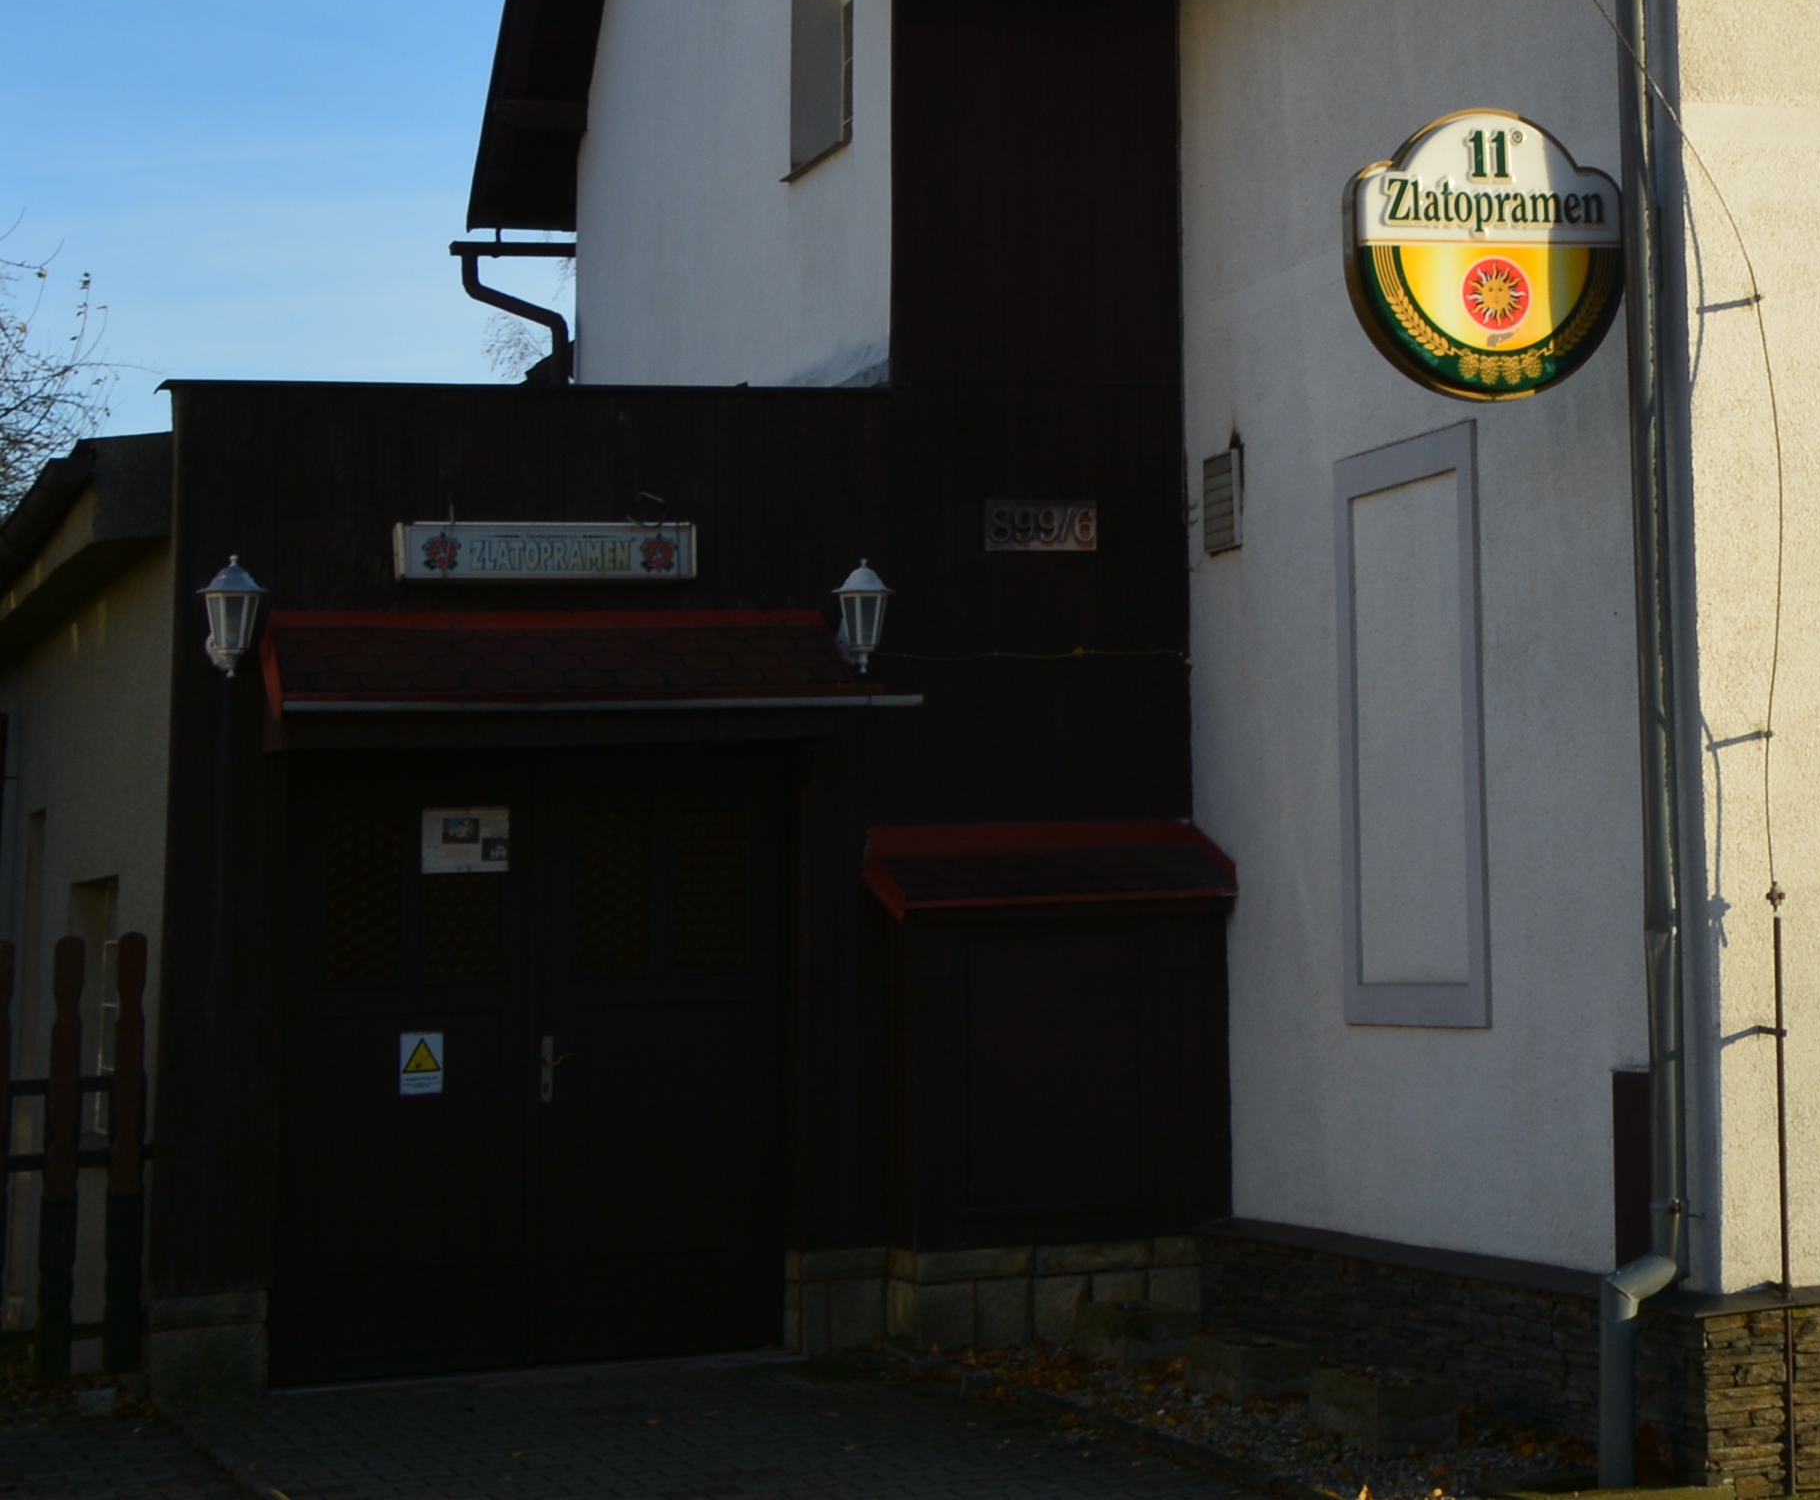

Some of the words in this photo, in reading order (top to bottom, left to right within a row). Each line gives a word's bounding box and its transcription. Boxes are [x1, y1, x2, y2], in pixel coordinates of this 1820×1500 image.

[1386, 178, 1605, 233] Zlatopramen
[990, 507, 1095, 543] 899/6
[469, 539, 633, 571] ZLATOPRAMEN
